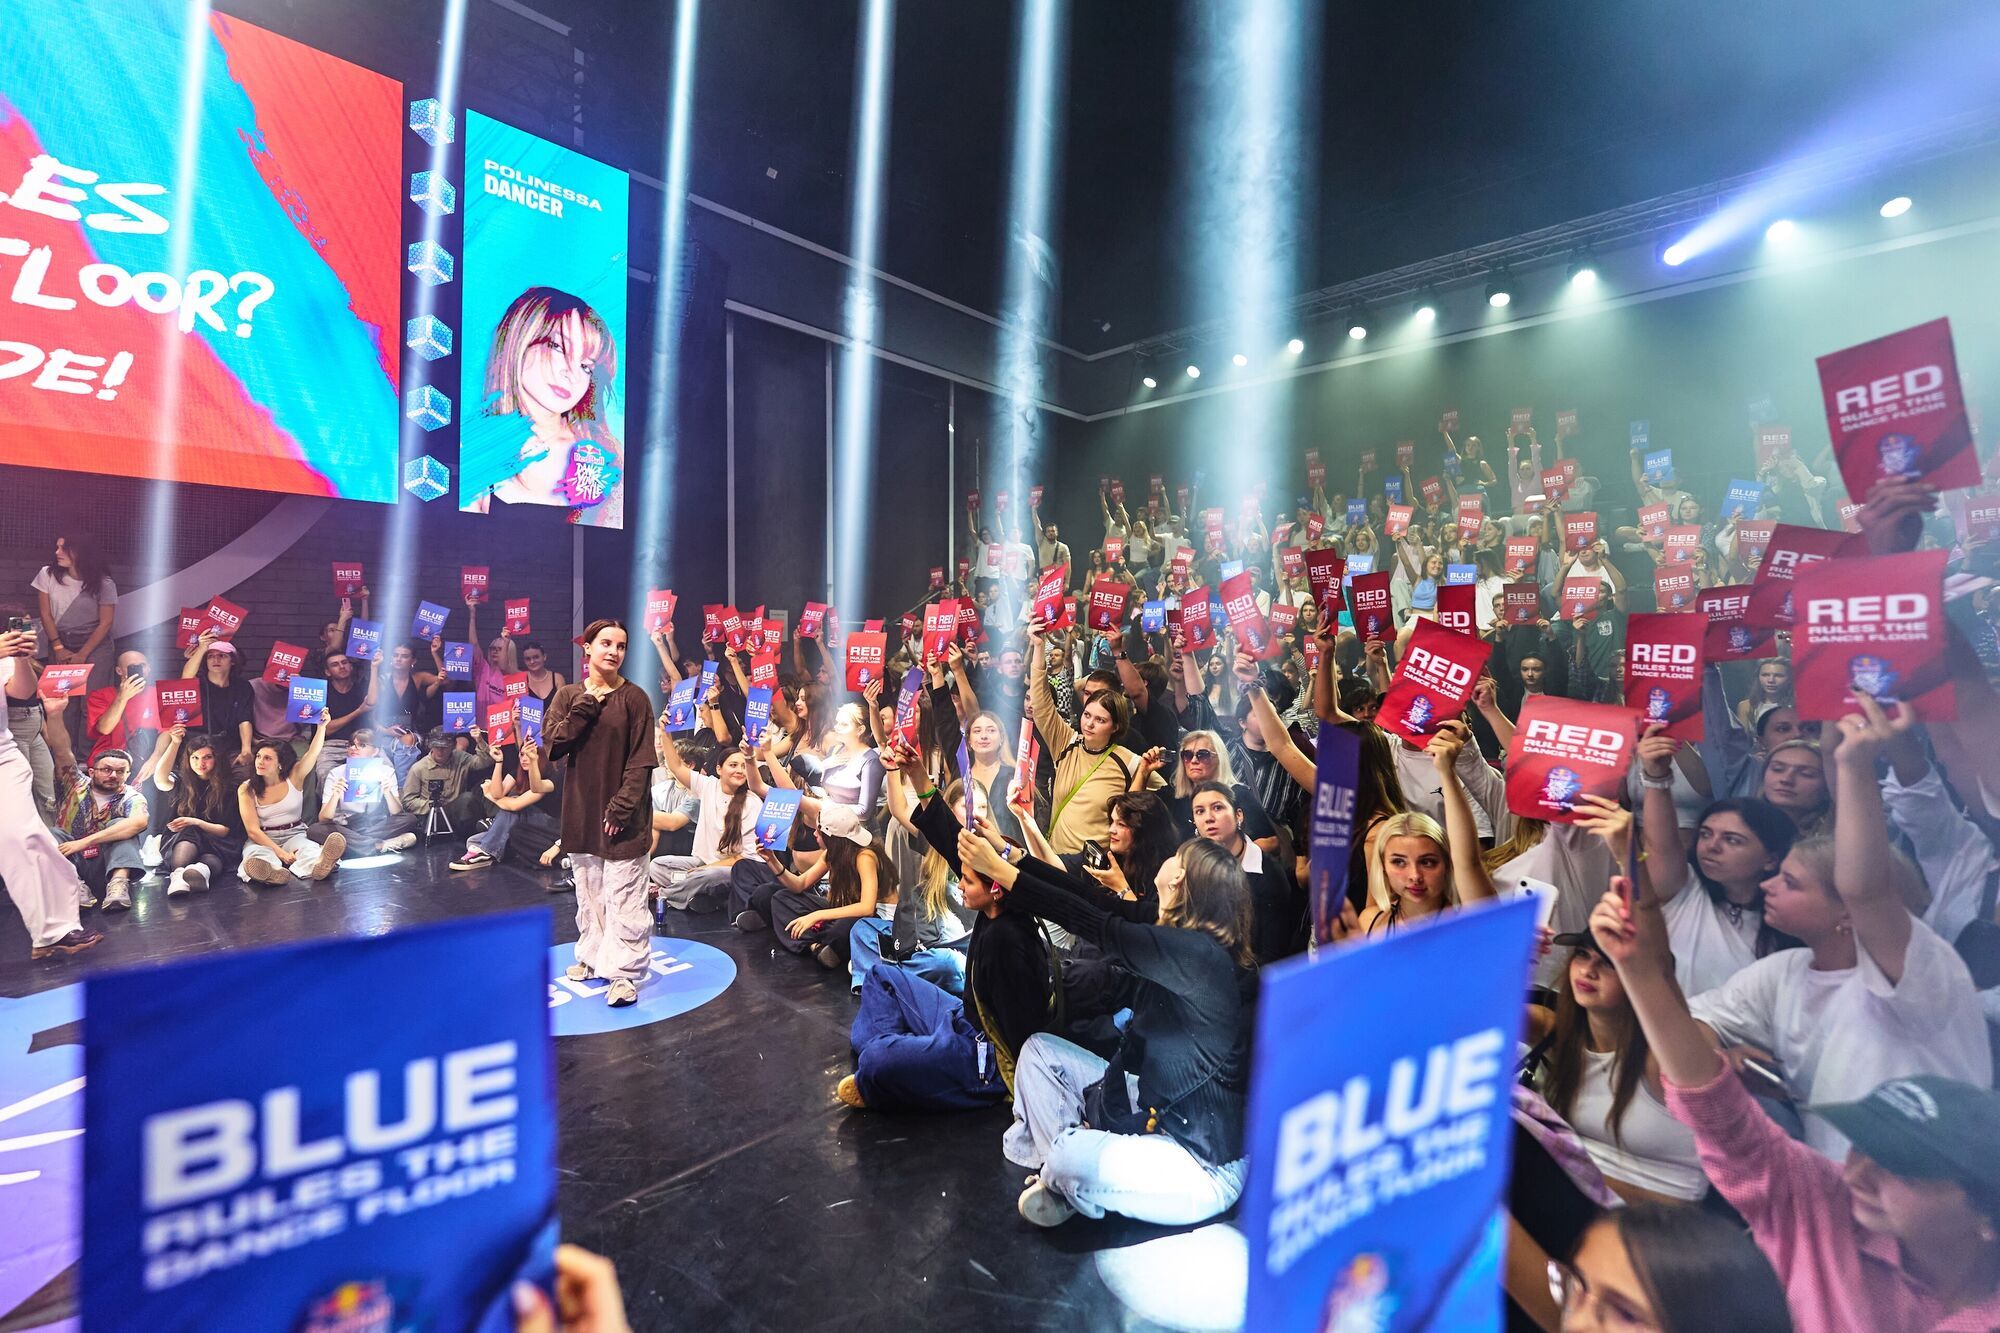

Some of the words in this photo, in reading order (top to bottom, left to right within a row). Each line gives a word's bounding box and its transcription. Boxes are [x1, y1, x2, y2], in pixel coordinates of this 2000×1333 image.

[484, 159, 603, 212] POLINESSA
[0, 154, 170, 235] ES
[484, 173, 563, 219] DANCER
[0, 237, 275, 339] LOOR?
[1836, 365, 1944, 414] RED
[1840, 403, 1898, 425] RULES
[1906, 391, 1945, 408] THE
[1842, 413, 1890, 432] DANCE
[1892, 402, 1947, 420] FLOOR
[1647, 456, 1669, 466] BLUE
[1543, 475, 1563, 484] RED
[1422, 482, 1440, 492] RED
[1731, 488, 1760, 498] BLUE
[1389, 511, 1409, 519] RED
[1460, 516, 1480, 525] RED
[1642, 510, 1667, 522] RED
[1310, 519, 1323, 529] RED
[1568, 522, 1594, 530] RED
[1740, 530, 1771, 538] RED
[1284, 553, 1301, 561] RED
[1348, 561, 1369, 569] BLUE
[1040, 577, 1062, 596] RED
[1659, 575, 1689, 587] RED
[1094, 592, 1123, 604] RED
[1356, 589, 1387, 602] RED
[649, 600, 669, 609] RED
[1183, 601, 1207, 617] RED
[1226, 594, 1254, 615] RED
[1807, 593, 1929, 624] RED
[210, 605, 239, 624] RED
[420, 609, 444, 621] BLUE
[507, 607, 528, 615] RED
[1272, 611, 1294, 620] RED
[183, 618, 200, 626] RE
[723, 616, 740, 628] RED
[903, 618, 914, 626] RED
[938, 614, 954, 624] RED
[353, 627, 379, 638] BLUE
[1808, 623, 1876, 635] RULES
[1881, 621, 1928, 631] THE
[1808, 634, 1864, 643] DANCE
[1868, 631, 1929, 641] FLOOR
[850, 646, 882, 656] RED
[1632, 643, 1696, 664] RED
[273, 651, 301, 664] RED
[753, 663, 773, 676] RED
[1408, 646, 1472, 686] RED
[1632, 663, 1666, 671] RULES
[703, 671, 715, 680] BLUE
[1405, 664, 1438, 684] RULES
[1442, 681, 1464, 695] THE
[1663, 672, 1693, 680] FLOOR
[293, 686, 324, 697] BLUE
[506, 682, 526, 692] RED
[1402, 671, 1430, 688] DANCE
[1430, 683, 1460, 701] FLOOR
[161, 690, 197, 700] RED
[673, 688, 693, 700] BLUE
[447, 701, 473, 709] BLUE
[748, 700, 769, 712] BLUE
[489, 711, 510, 722] RED
[522, 706, 541, 717] BLUE
[1526, 719, 1624, 751] RED
[1524, 739, 1578, 753] RULES
[1583, 747, 1618, 760] THE
[1522, 746, 1567, 758] DANCE
[1569, 753, 1616, 767] FLOOR
[765, 801, 796, 813] BLUE
[1316, 782, 1355, 820] BLUE
[1273, 1026, 1504, 1198] BLUE
[142, 1040, 518, 1211] BLUE
[142, 1160, 382, 1254] RULES
[400, 1124, 518, 1181] THE
[144, 1203, 348, 1290] DANCE
[356, 1159, 517, 1222] FLOOR
